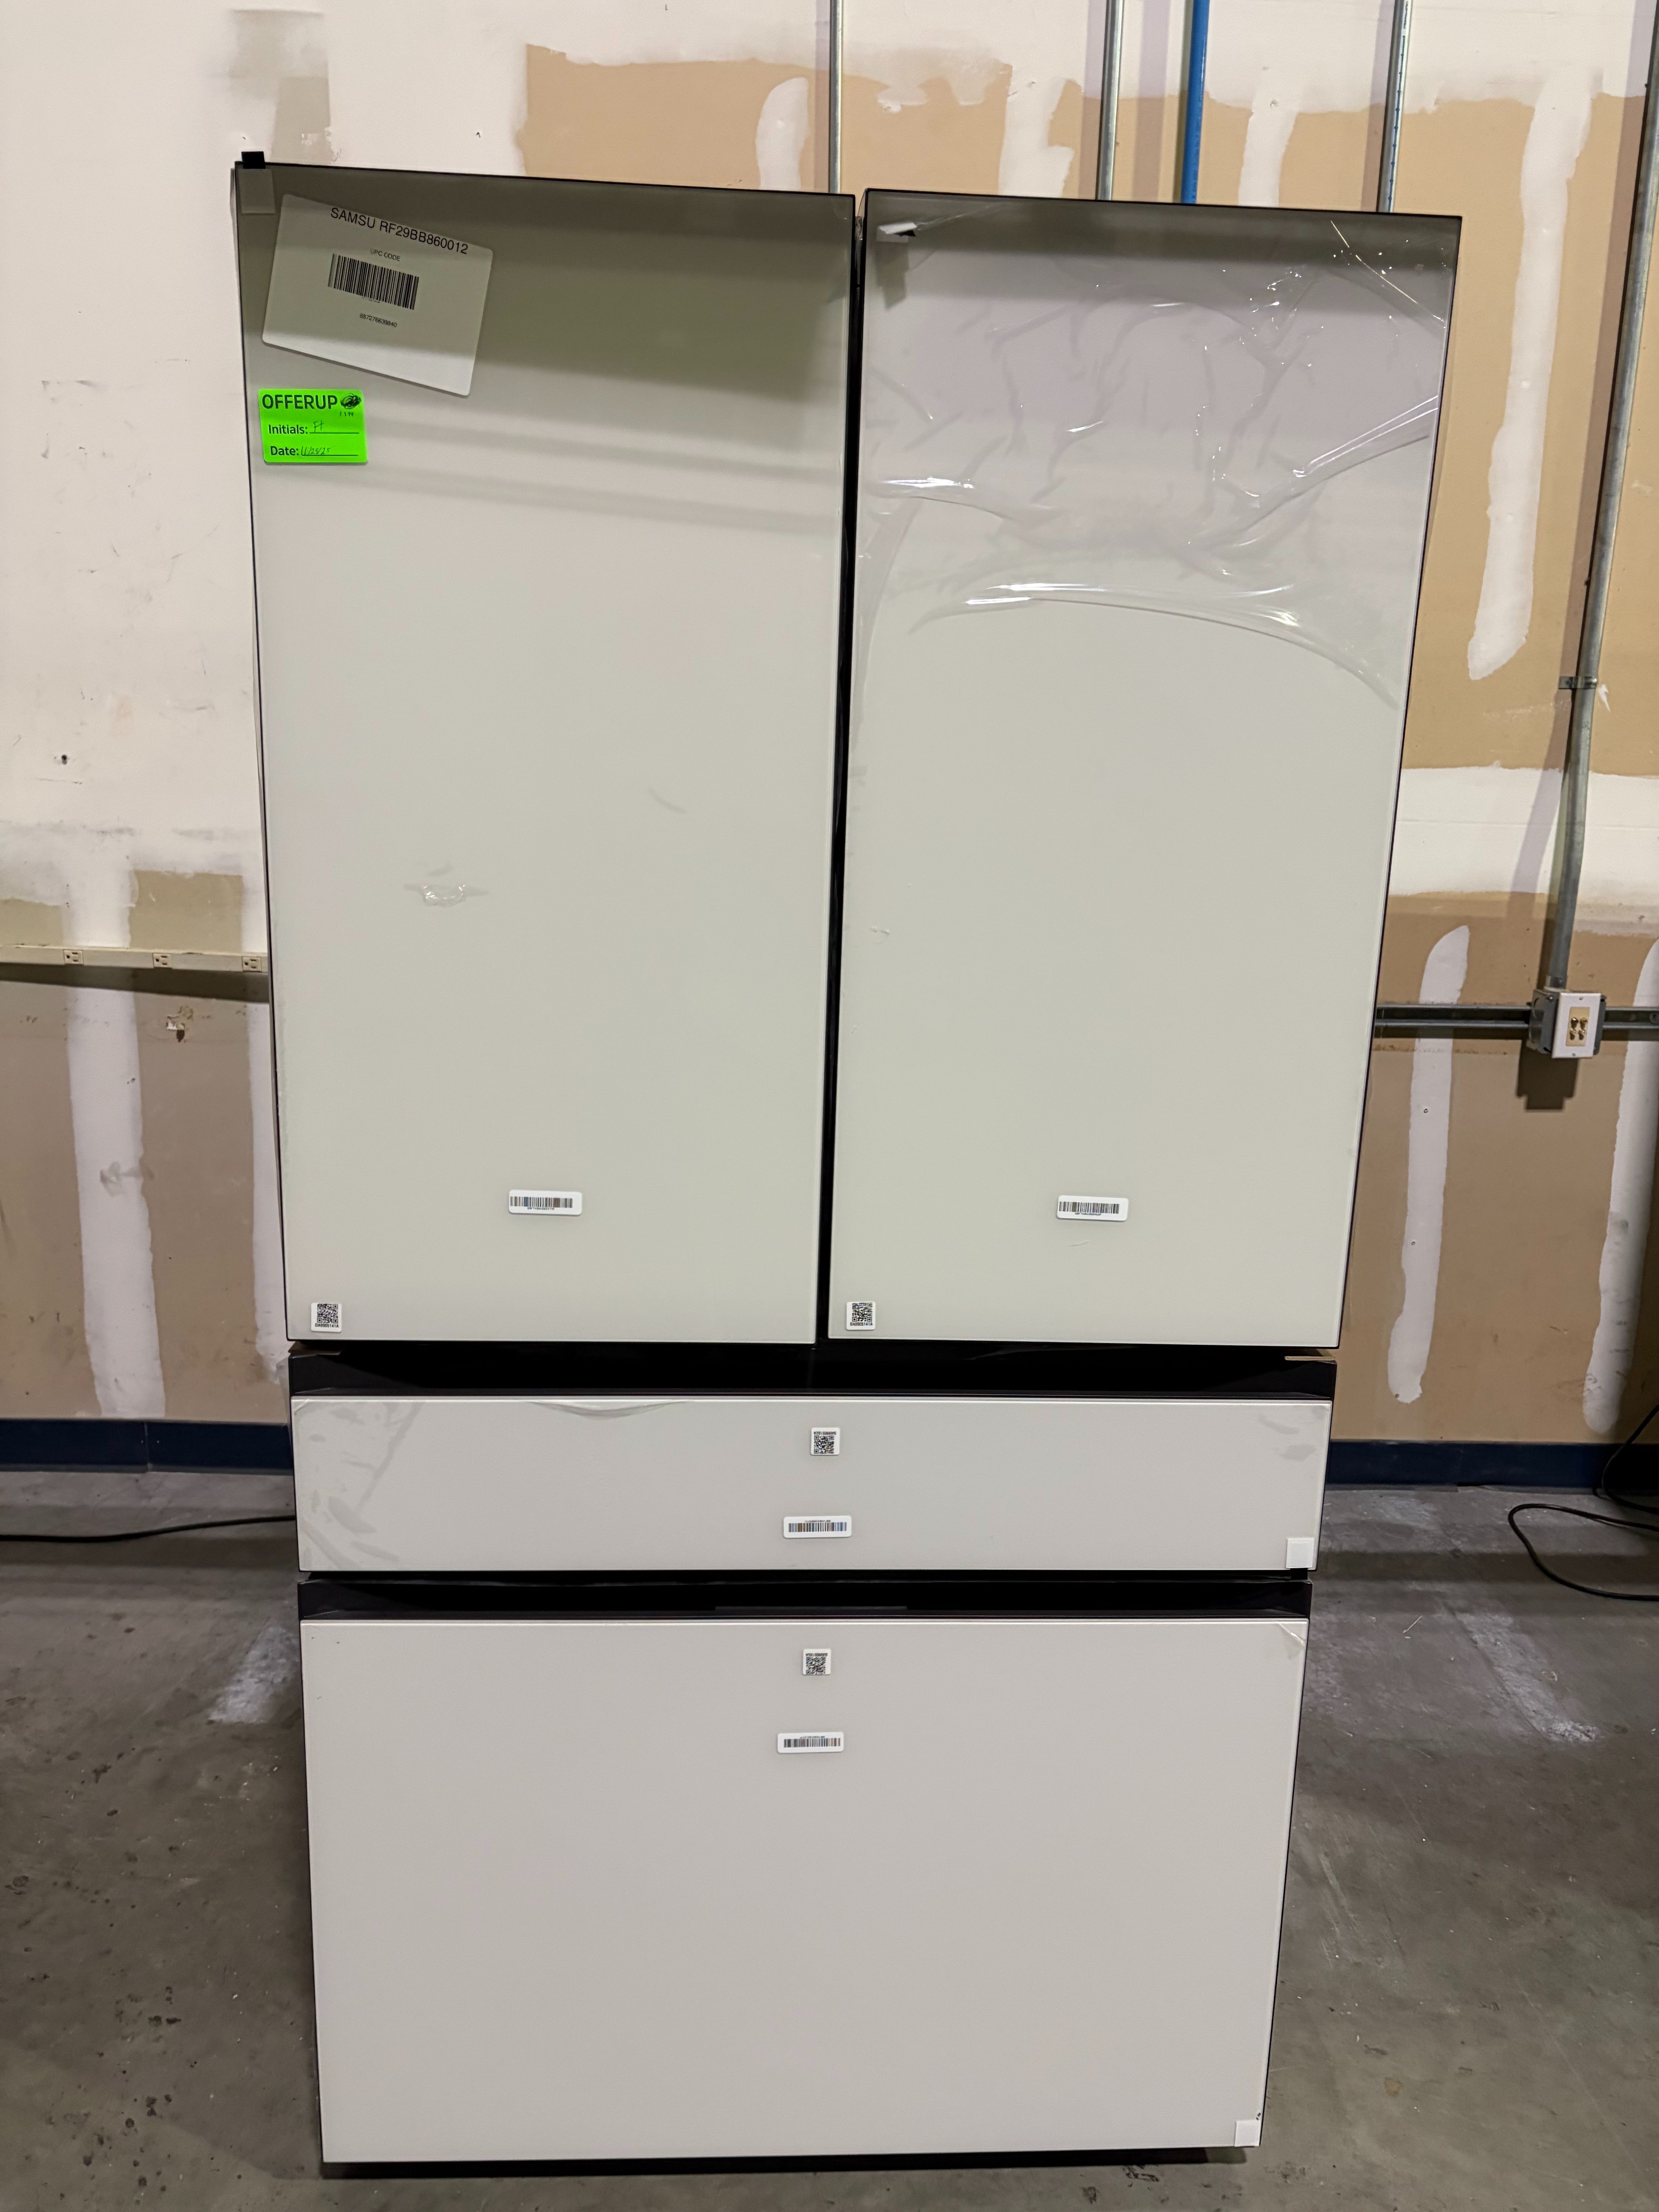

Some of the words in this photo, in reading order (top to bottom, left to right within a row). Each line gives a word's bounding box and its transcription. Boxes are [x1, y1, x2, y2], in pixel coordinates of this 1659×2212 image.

[331, 207, 376, 228] SAMSU
[379, 220, 469, 254] RF29BB860012
[370, 249, 383, 257] UPC
[383, 252, 401, 261] CODE
[262, 394, 338, 409] OFFERUP
[268, 424, 308, 434] Initials:
[270, 446, 299, 456] Date:
